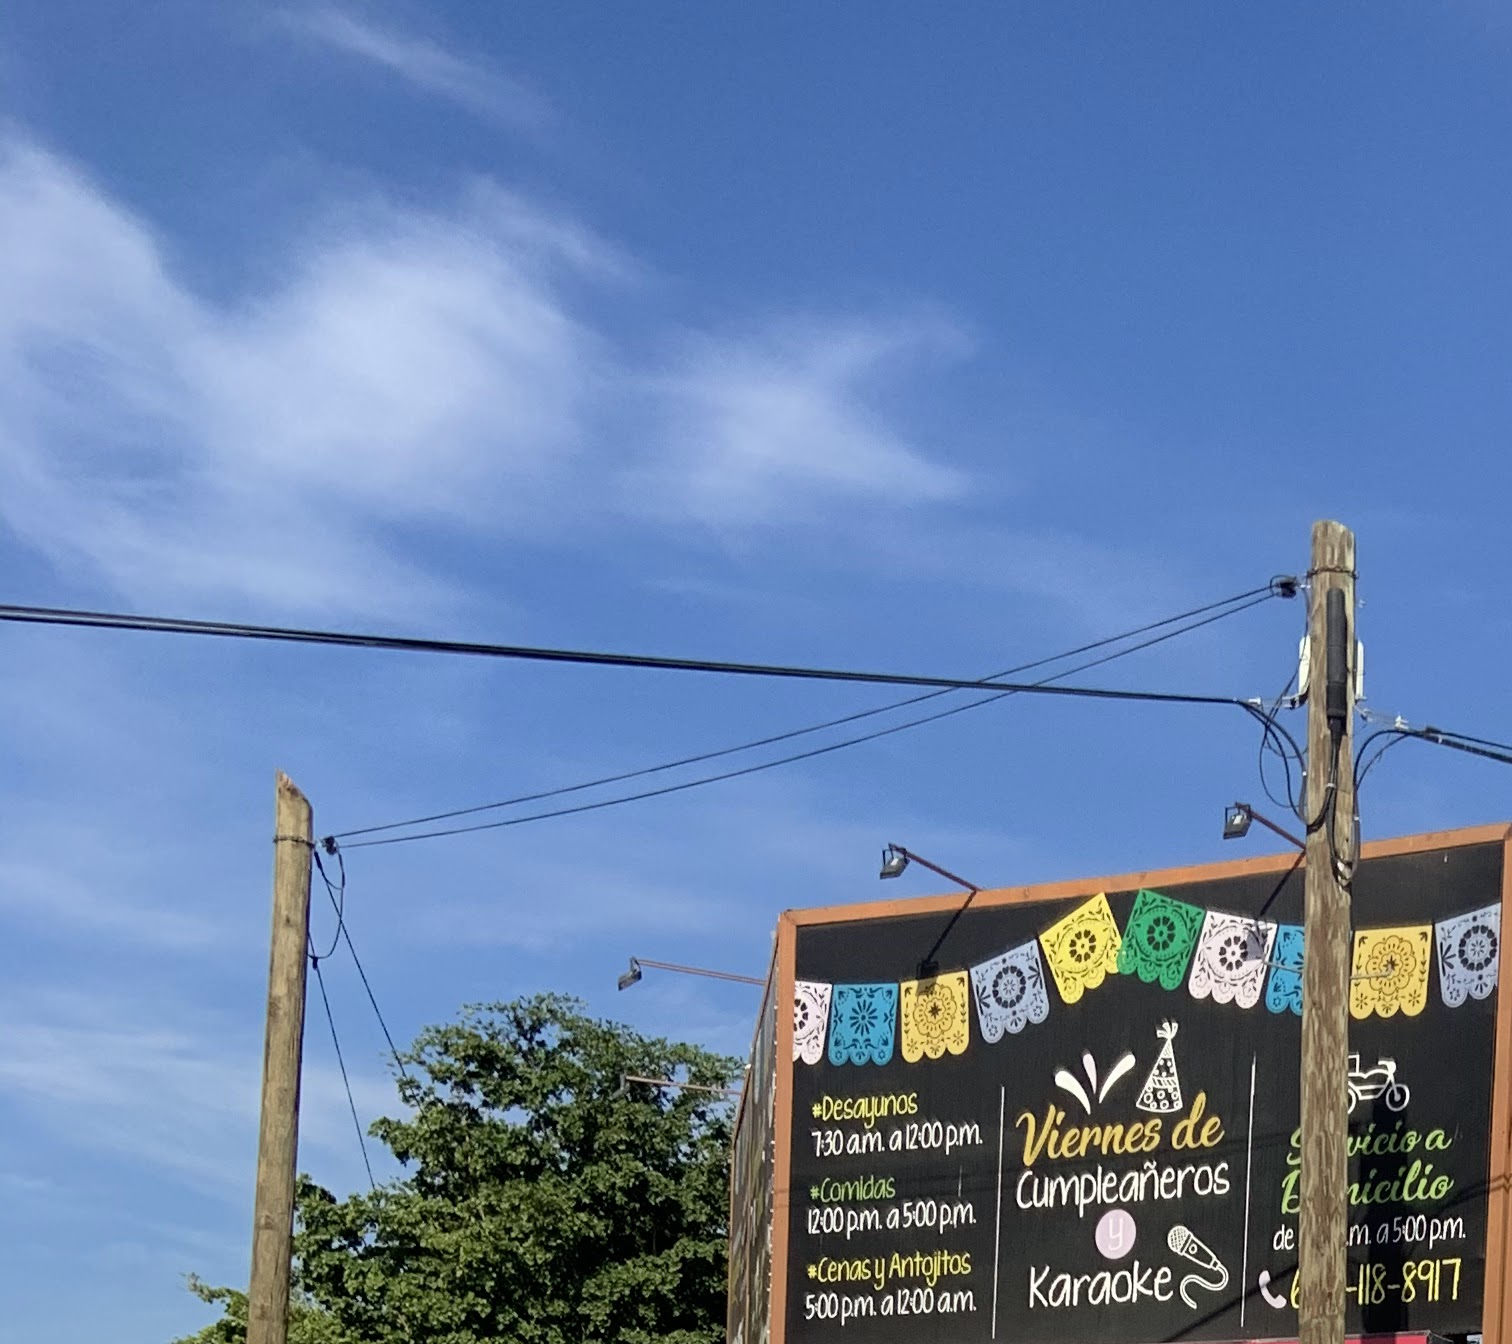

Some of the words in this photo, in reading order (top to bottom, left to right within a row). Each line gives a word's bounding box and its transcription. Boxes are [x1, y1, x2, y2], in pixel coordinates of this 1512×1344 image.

[812, 1092, 918, 1128] #Desayunos
[1016, 1104, 1162, 1166] Viernes
[1172, 1091, 1225, 1150] de
[811, 1129, 843, 1157] 7:30
[846, 1131, 885, 1153] a.m.
[889, 1129, 902, 1151] a
[905, 1121, 942, 1150] 12:00
[945, 1123, 983, 1155] p.m.
[1286, 1122, 1421, 1166] Svicio
[1425, 1129, 1453, 1150] a
[810, 1174, 896, 1202] #Comidas
[1016, 1160, 1230, 1218] Cumpleañeros
[808, 1206, 843, 1234] 12:00
[846, 1209, 882, 1240] p.m.
[886, 1208, 899, 1229] a
[903, 1200, 937, 1228] 5:00
[940, 1203, 977, 1234] p.m.
[1108, 1217, 1123, 1251] y
[1273, 1224, 1294, 1250] de
[1376, 1223, 1388, 1244] a
[1393, 1214, 1427, 1243] 5:00
[1430, 1217, 1466, 1249] p.m.
[808, 1257, 871, 1282] #Cenas
[874, 1258, 885, 1291] y
[889, 1250, 972, 1287] Antojitos
[1029, 1260, 1174, 1309] Karaoke
[1290, 1258, 1462, 1308] 6-118-8917
[805, 1293, 838, 1320] 5:00
[841, 1295, 877, 1326] p.m.
[881, 1294, 893, 1316] a
[897, 1288, 933, 1315] 12:00
[937, 1290, 977, 1313] a.m.
